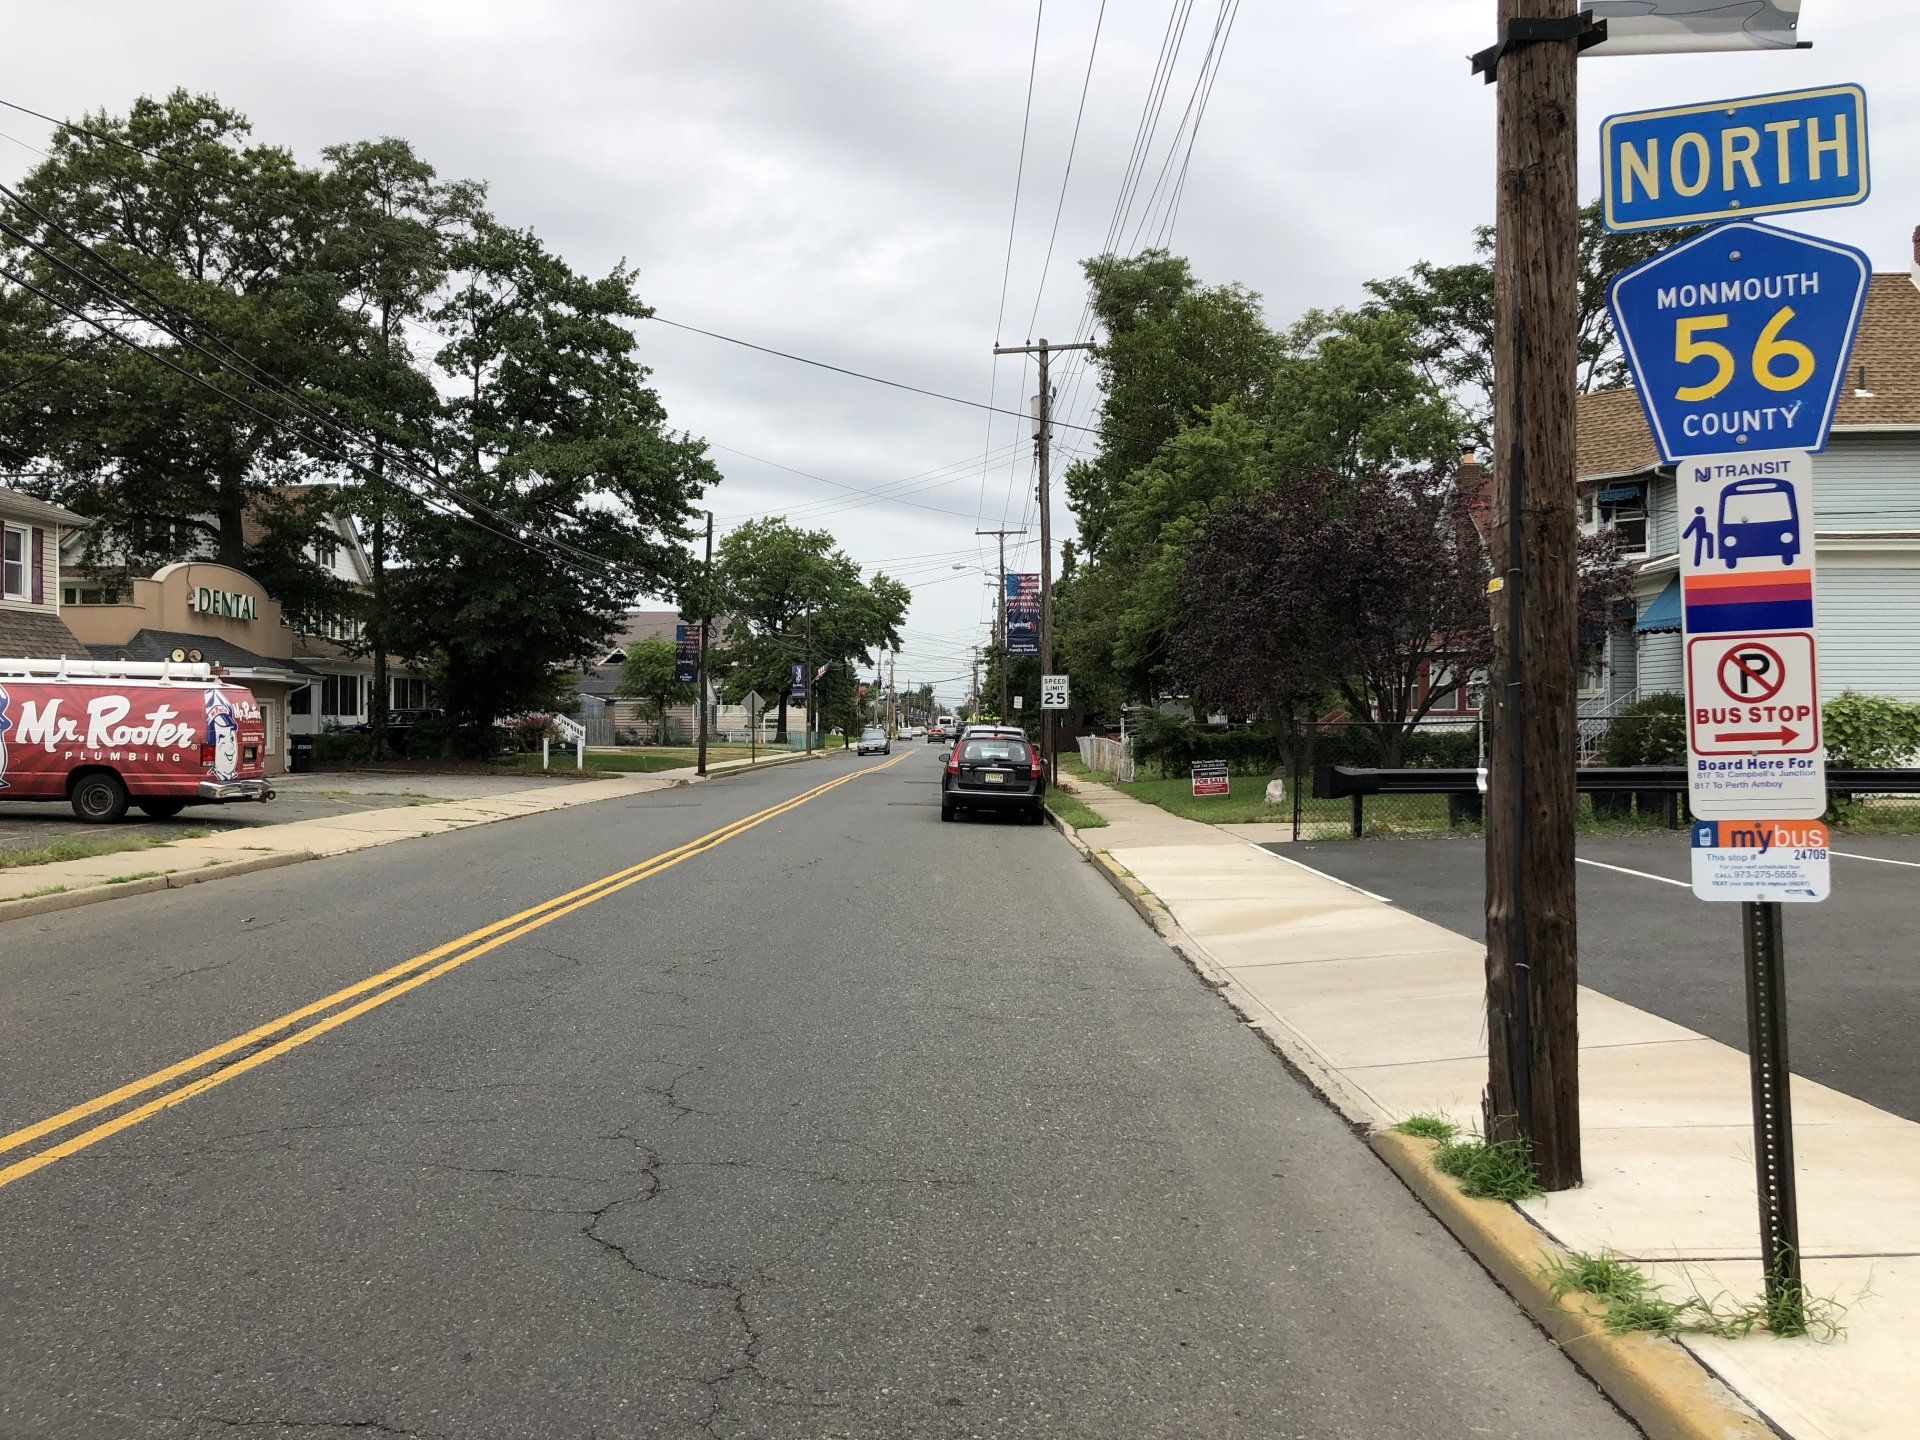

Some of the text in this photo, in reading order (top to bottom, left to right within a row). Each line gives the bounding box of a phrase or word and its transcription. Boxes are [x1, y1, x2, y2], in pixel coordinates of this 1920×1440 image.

[1620, 113, 1849, 204] NORTH
[1657, 271, 1820, 310] MONMOUTH
[1674, 305, 1816, 402] 56
[1682, 406, 1800, 437] COUNTY
[1714, 460, 1791, 478] TRANSIT
[196, 587, 259, 620] DENTAL
[1044, 692, 1066, 705] 25
[15, 694, 196, 753] Mr. Rooter
[1695, 705, 1811, 725] BUS STOP
[65, 751, 181, 762] PLUMBING
[1697, 757, 1814, 771] Board Here For
[1696, 769, 1817, 779] 817 To Campbell's Junction
[1694, 780, 1783, 790] 817 To Perth Amboy
[1731, 824, 1824, 855] mybus
[1706, 853, 1725, 861] This
[1727, 853, 1748, 862] stop
[1794, 848, 1827, 861] 24709
